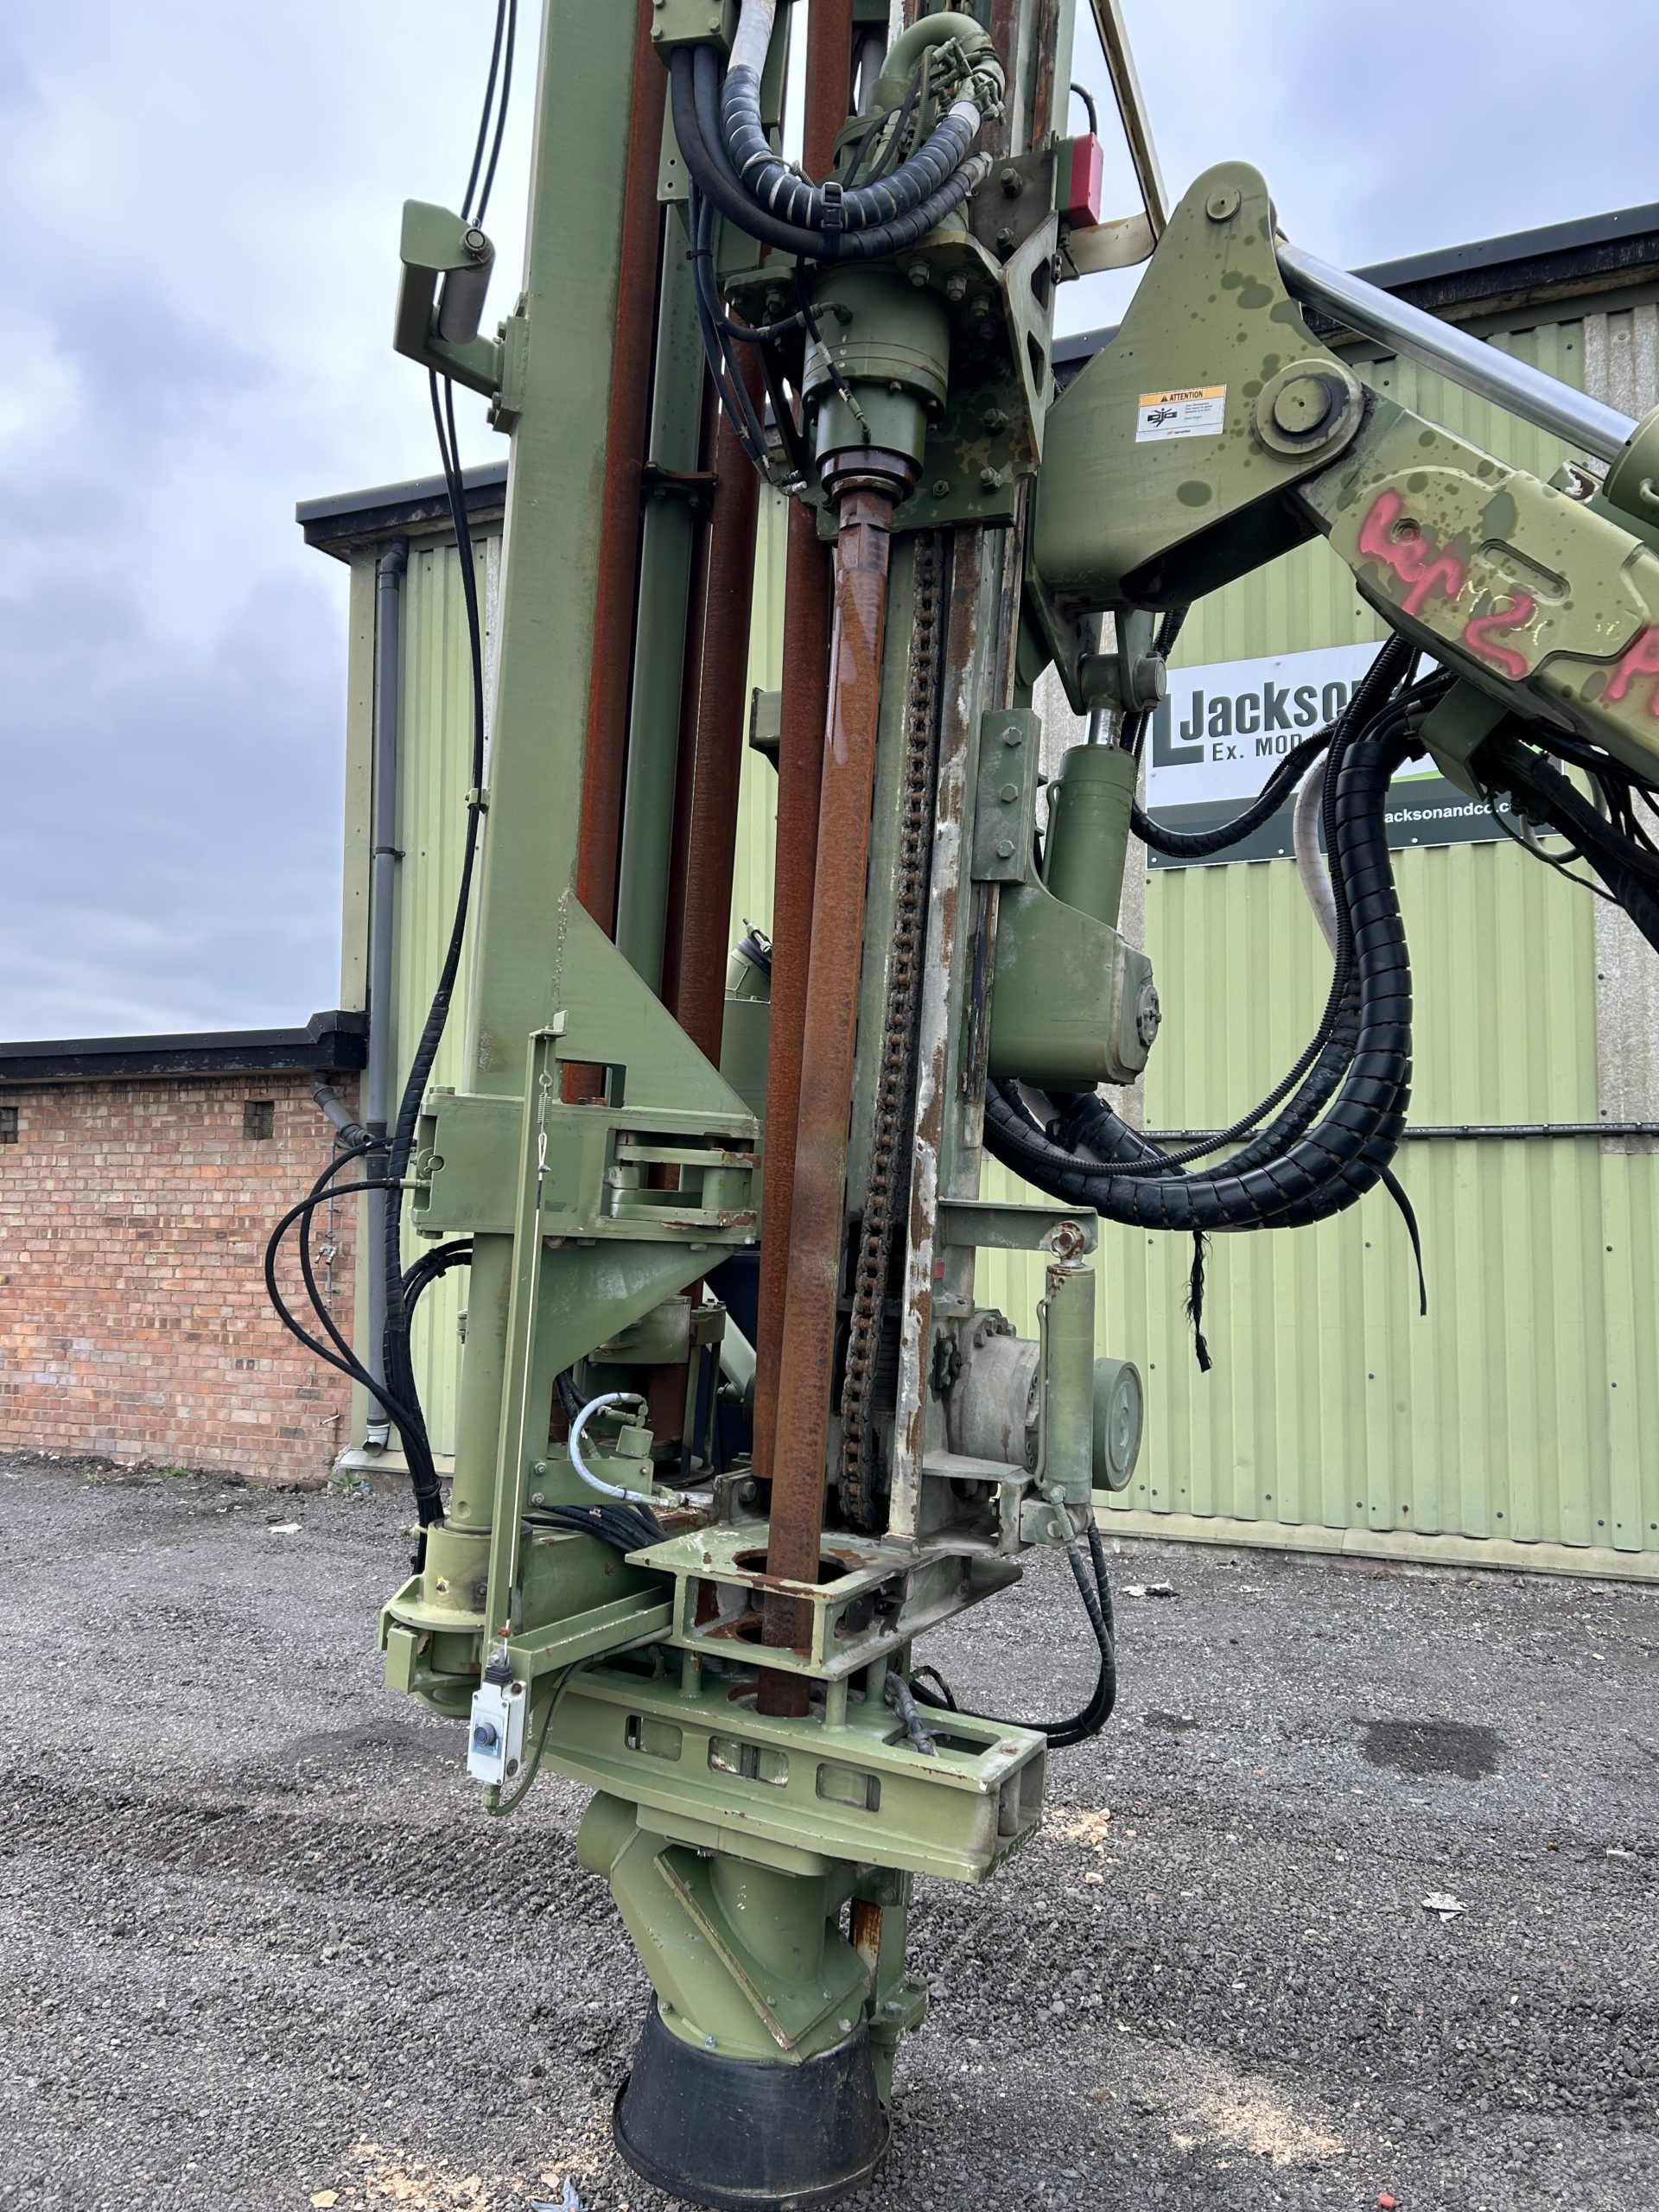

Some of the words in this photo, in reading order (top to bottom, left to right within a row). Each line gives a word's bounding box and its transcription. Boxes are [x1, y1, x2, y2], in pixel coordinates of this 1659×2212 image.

[1169, 391, 1204, 402] ATTENTION
[1212, 742, 1244, 761] Ex.
[1384, 802, 1512, 823] acksonandco.c
